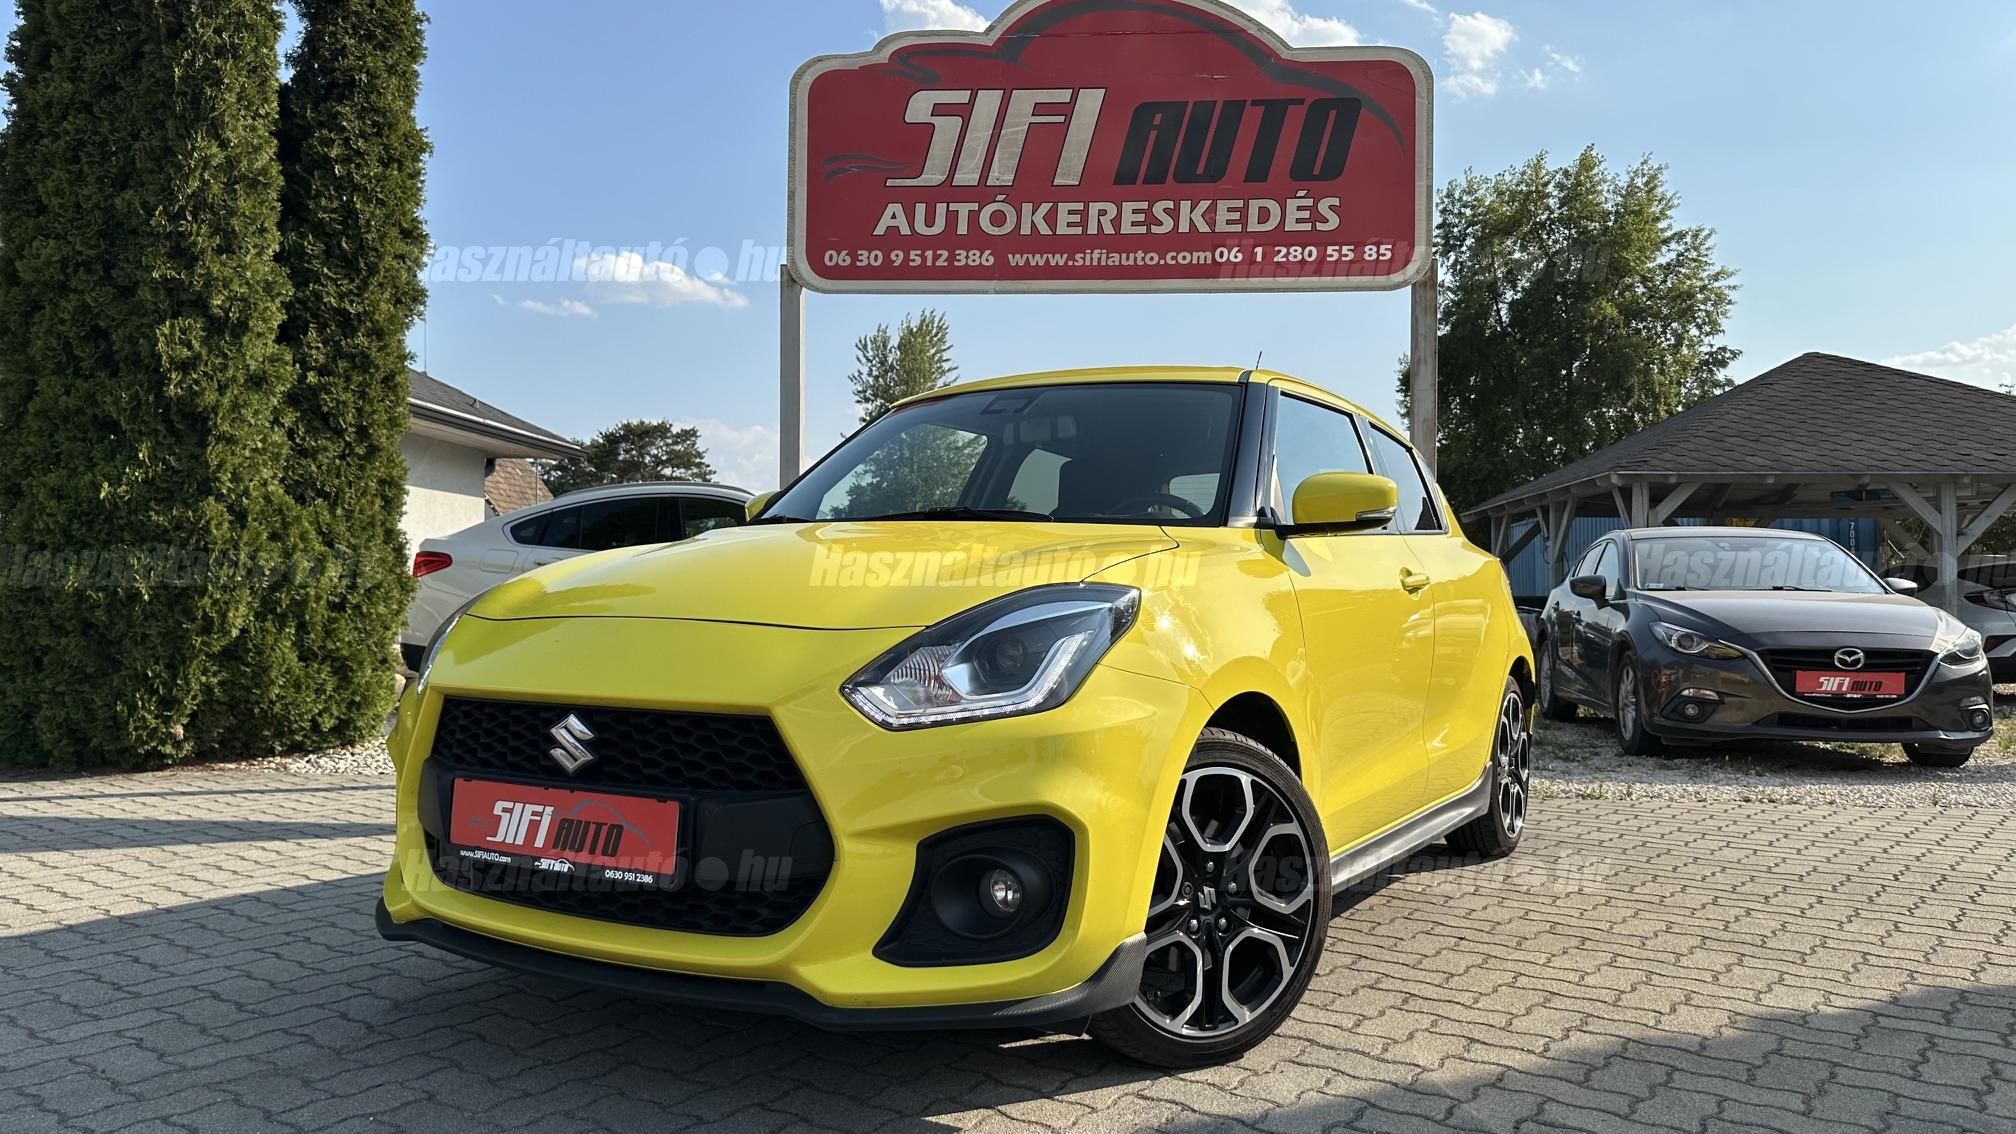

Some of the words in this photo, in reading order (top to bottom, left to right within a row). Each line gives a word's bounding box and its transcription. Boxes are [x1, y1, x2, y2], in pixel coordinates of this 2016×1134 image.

[885, 88, 1106, 187] SIFI
[1112, 98, 1362, 185] AUTO
[872, 191, 1342, 238] AUTÓKERESKEDÉS
[824, 250, 851, 266] 06
[856, 250, 883, 266] 30
[890, 250, 904, 266] 9
[909, 250, 948, 266] 512
[954, 250, 995, 266] 386
[1007, 249, 1212, 266] www.sifiauto.com
[1215, 247, 1243, 262] 06
[1254, 247, 1263, 262] 1
[1273, 246, 1317, 262] 280
[1326, 246, 1355, 261] 55
[1363, 245, 1393, 261] 85
[1816, 677, 1851, 691] SIFI
[1851, 680, 1883, 692] AUTO
[486, 800, 554, 849] SIFI
[552, 818, 625, 858] AUTO
[605, 869, 623, 880] 0630
[624, 871, 636, 882] 951
[636, 872, 653, 884] 2386
